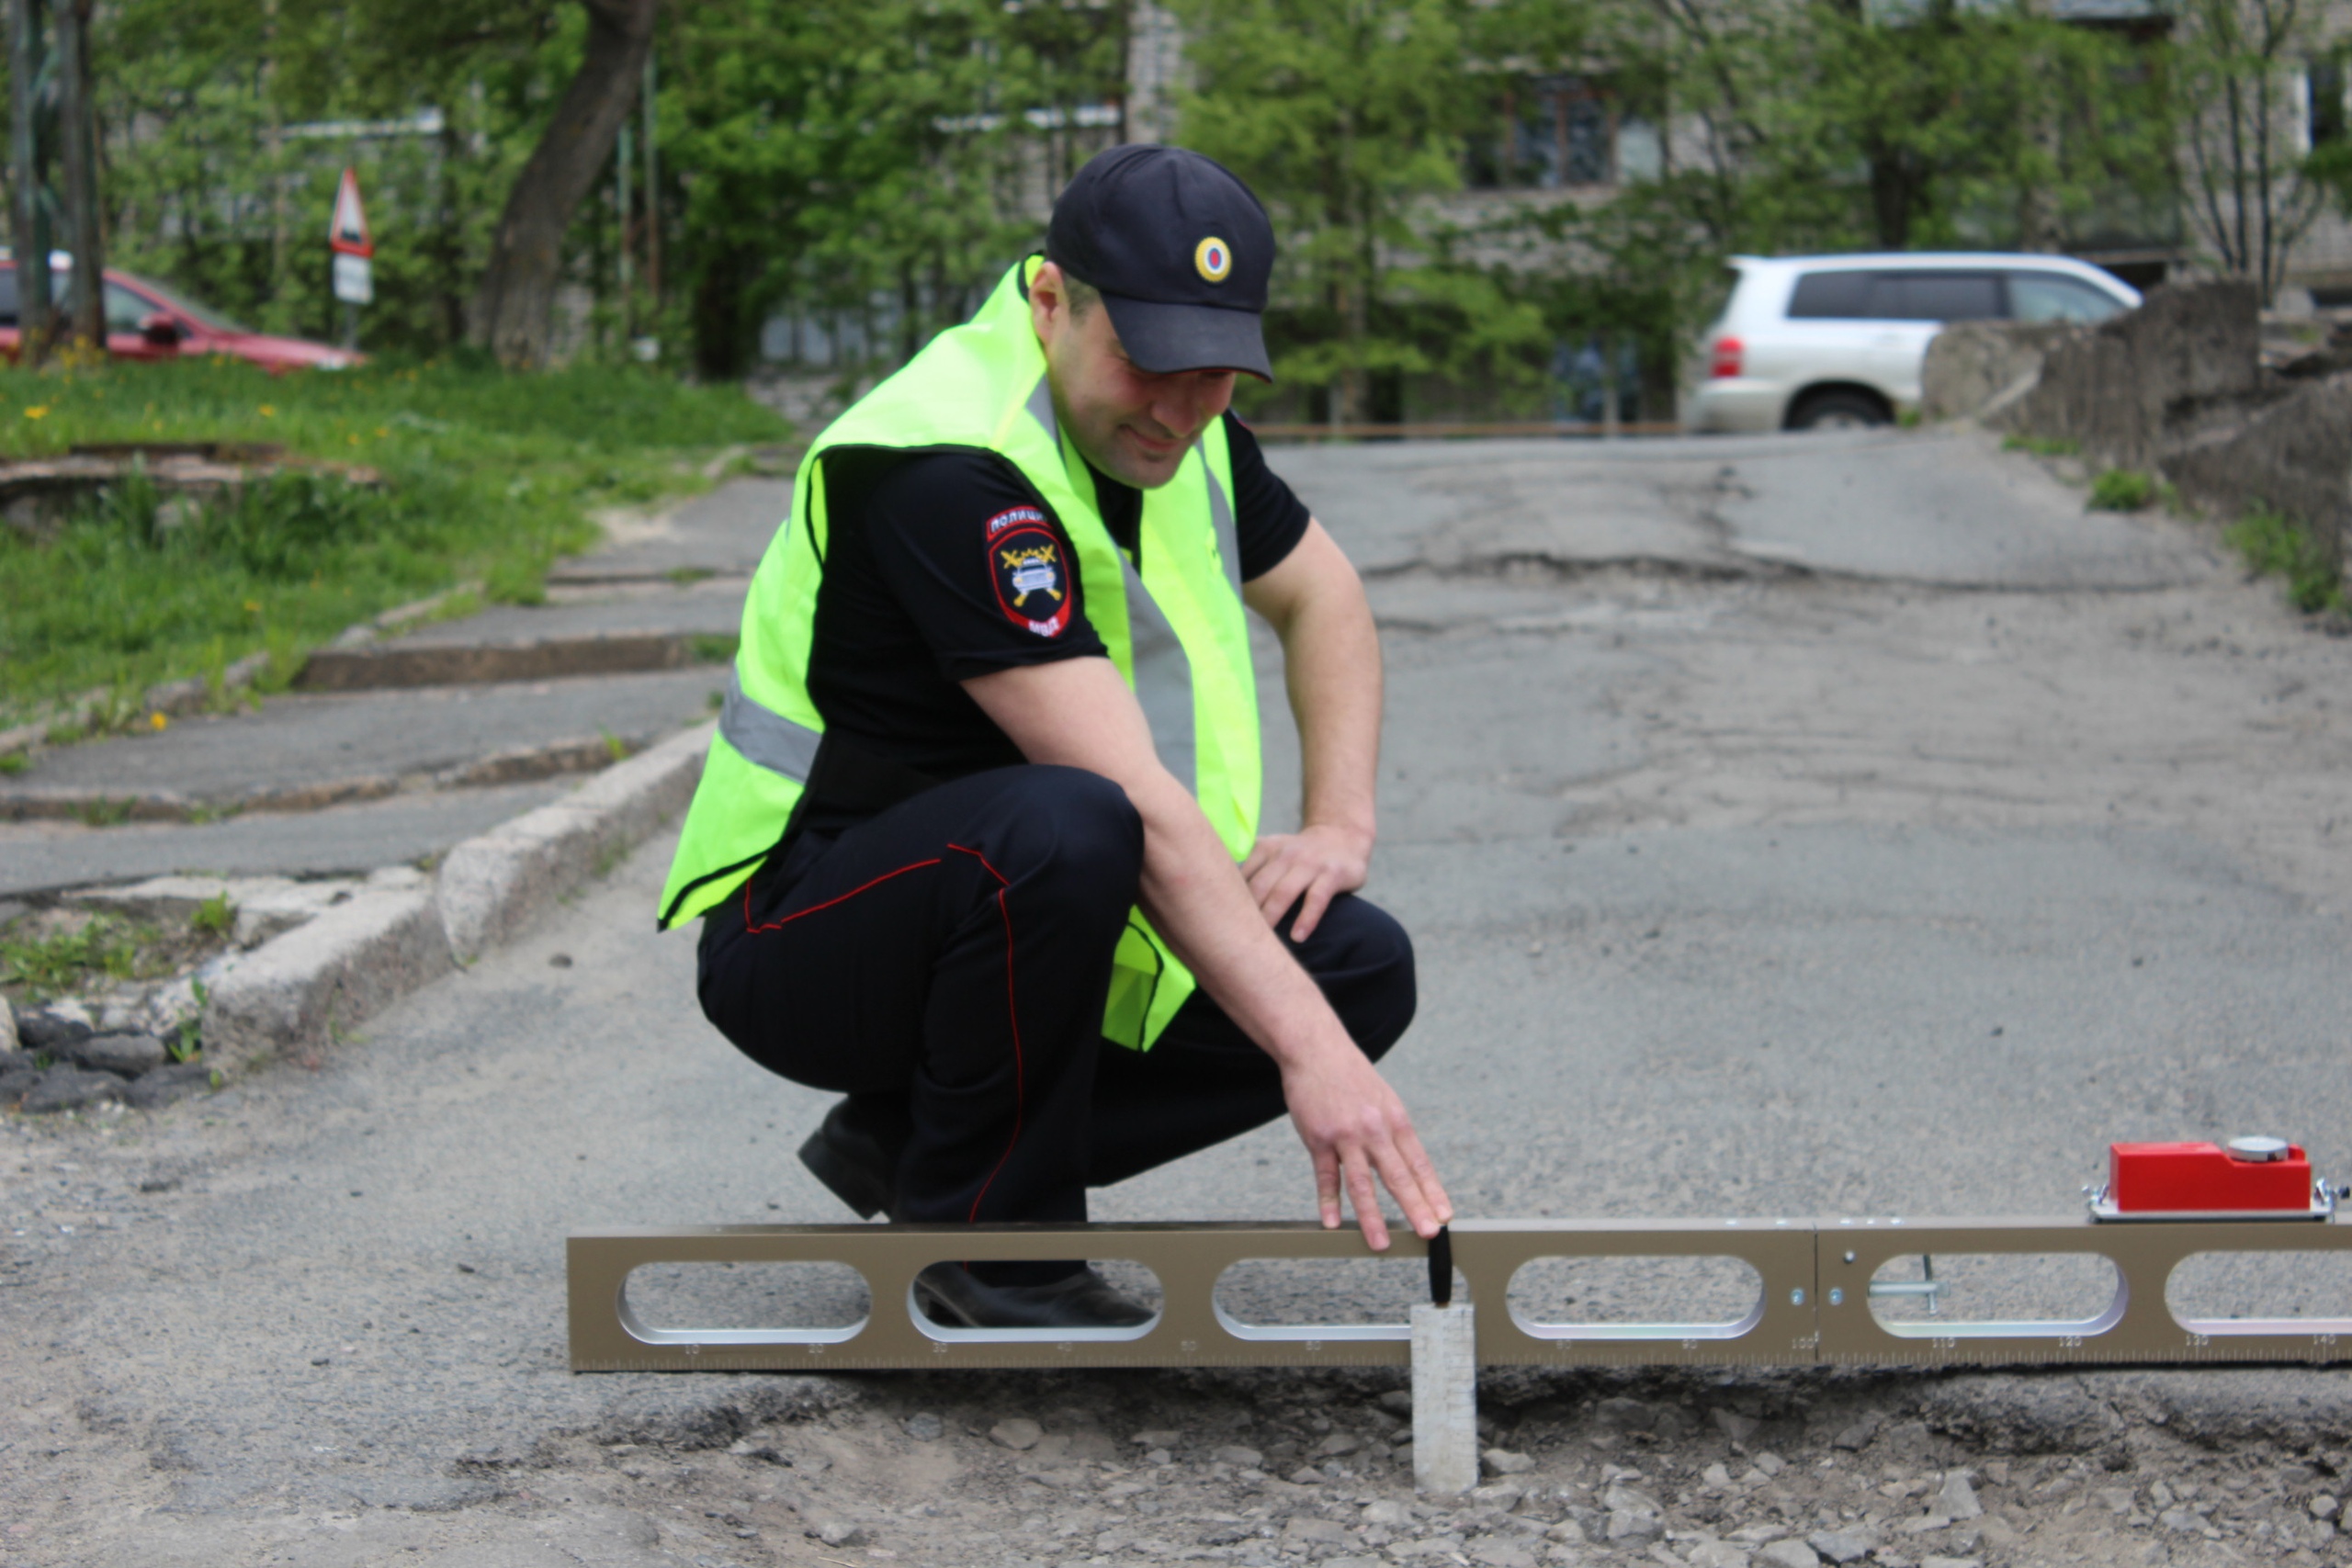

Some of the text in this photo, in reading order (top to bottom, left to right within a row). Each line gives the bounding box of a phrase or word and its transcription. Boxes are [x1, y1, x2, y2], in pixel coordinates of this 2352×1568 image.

[1932, 1337, 1955, 1348] 110
[2059, 1336, 2082, 1348] 120
[2186, 1335, 2209, 1347] 130
[2313, 1334, 2336, 1346] 140
